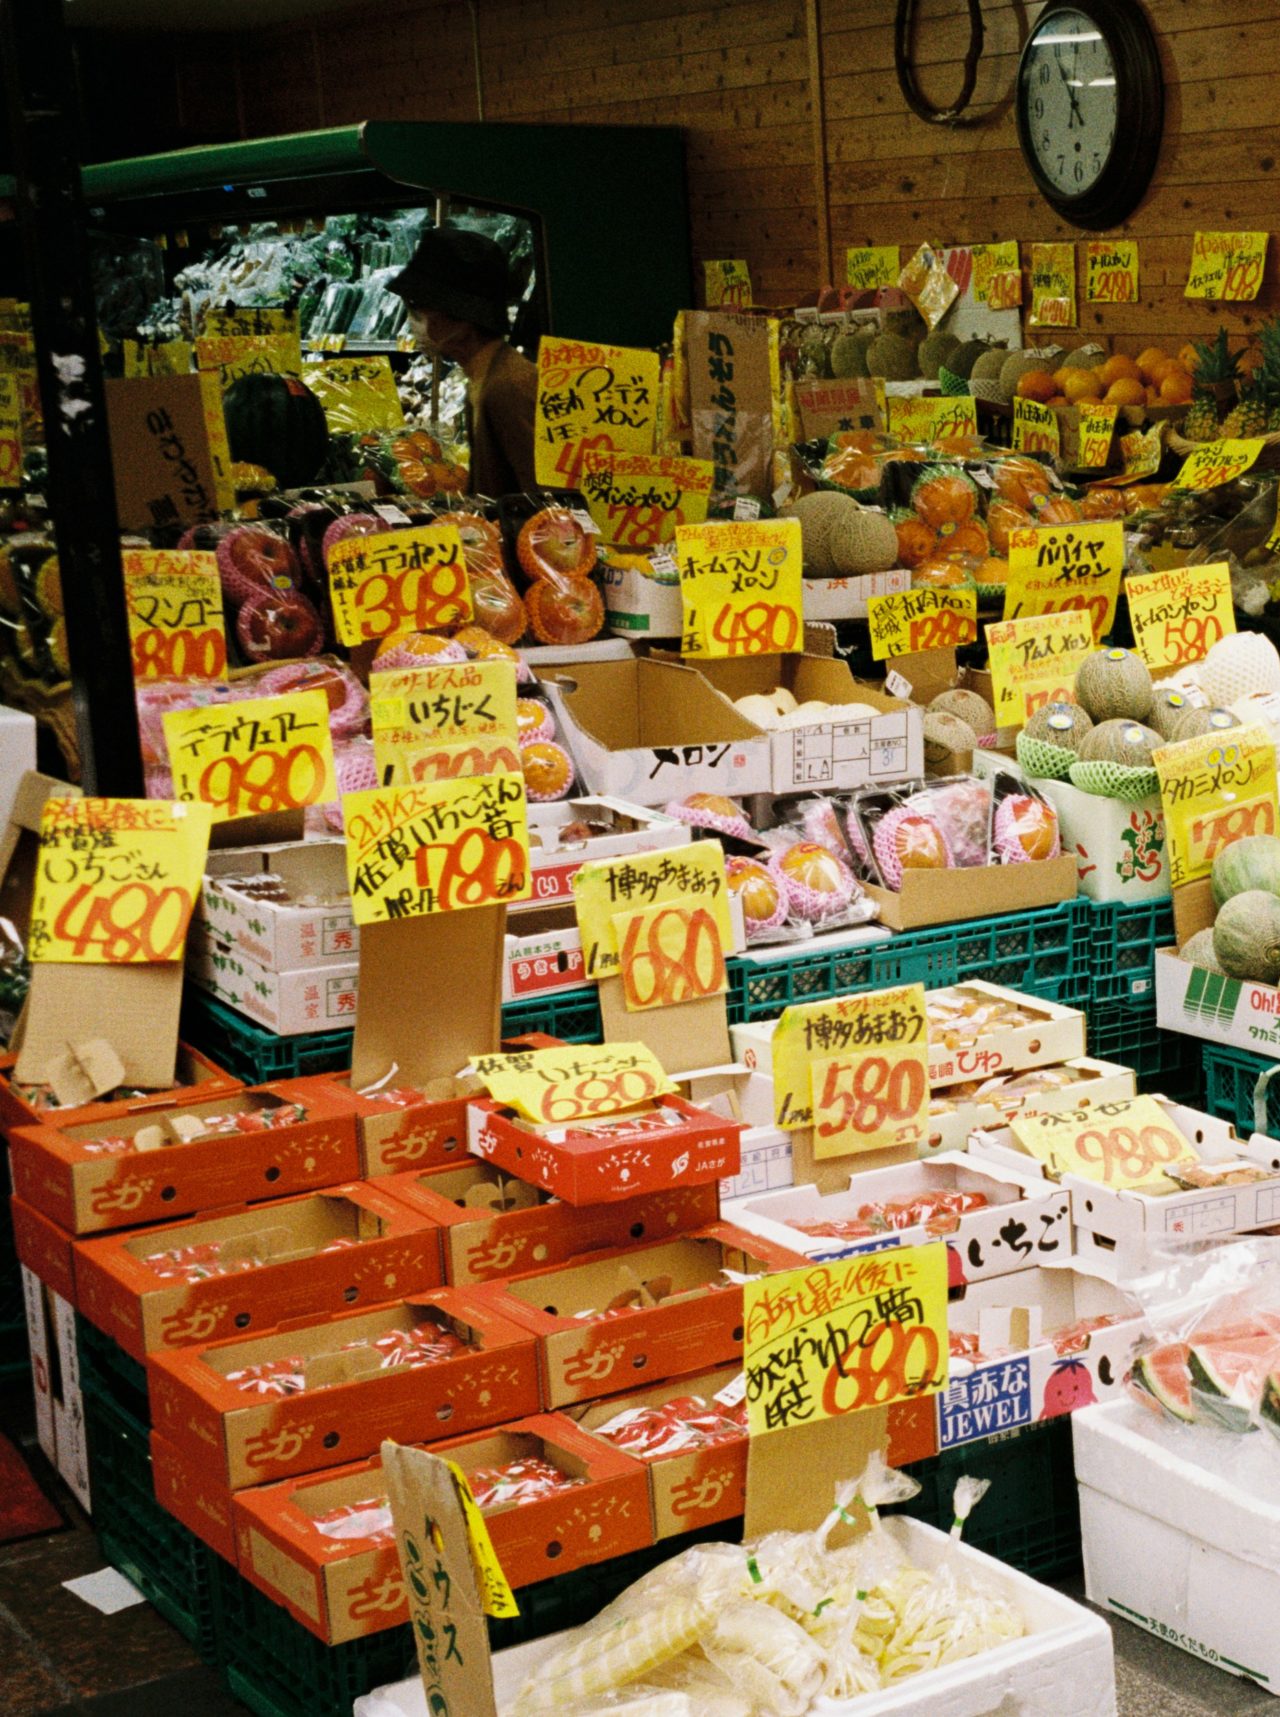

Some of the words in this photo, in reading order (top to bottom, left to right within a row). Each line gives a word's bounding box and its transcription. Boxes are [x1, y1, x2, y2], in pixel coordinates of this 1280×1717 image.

[1034, 97, 1044, 120] 9
[1057, 153, 1066, 175] 7
[1073, 160, 1084, 183] 6
[607, 503, 685, 547] 780
[731, 569, 779, 594] メロン
[1055, 562, 1112, 583] メロン
[132, 594, 225, 629] マンゴー
[355, 563, 470, 638] 398
[712, 600, 799, 656] 480
[909, 609, 977, 652] 1280
[1162, 614, 1225, 666] 580
[408, 693, 497, 728] いちじく
[199, 743, 327, 817] 980
[1161, 760, 1253, 806] タカミメロン
[44, 849, 169, 885] いちごさん
[414, 826, 527, 912] 780
[605, 858, 722, 902] 博多あまおう
[54, 882, 191, 962] 480
[621, 908, 726, 1006] 680
[803, 1005, 924, 1051] 博多あまおう
[956, 1050, 1003, 1074] びわ
[541, 1069, 656, 1123] 680
[818, 1057, 926, 1138] 580
[597, 1149, 652, 1175] いちごさん
[1075, 1125, 1183, 1182] 980
[967, 1205, 1070, 1268] いちご
[821, 1319, 940, 1416] 680
[942, 1363, 1028, 1411] 真赤な
[941, 1398, 1029, 1443] JEWEL
